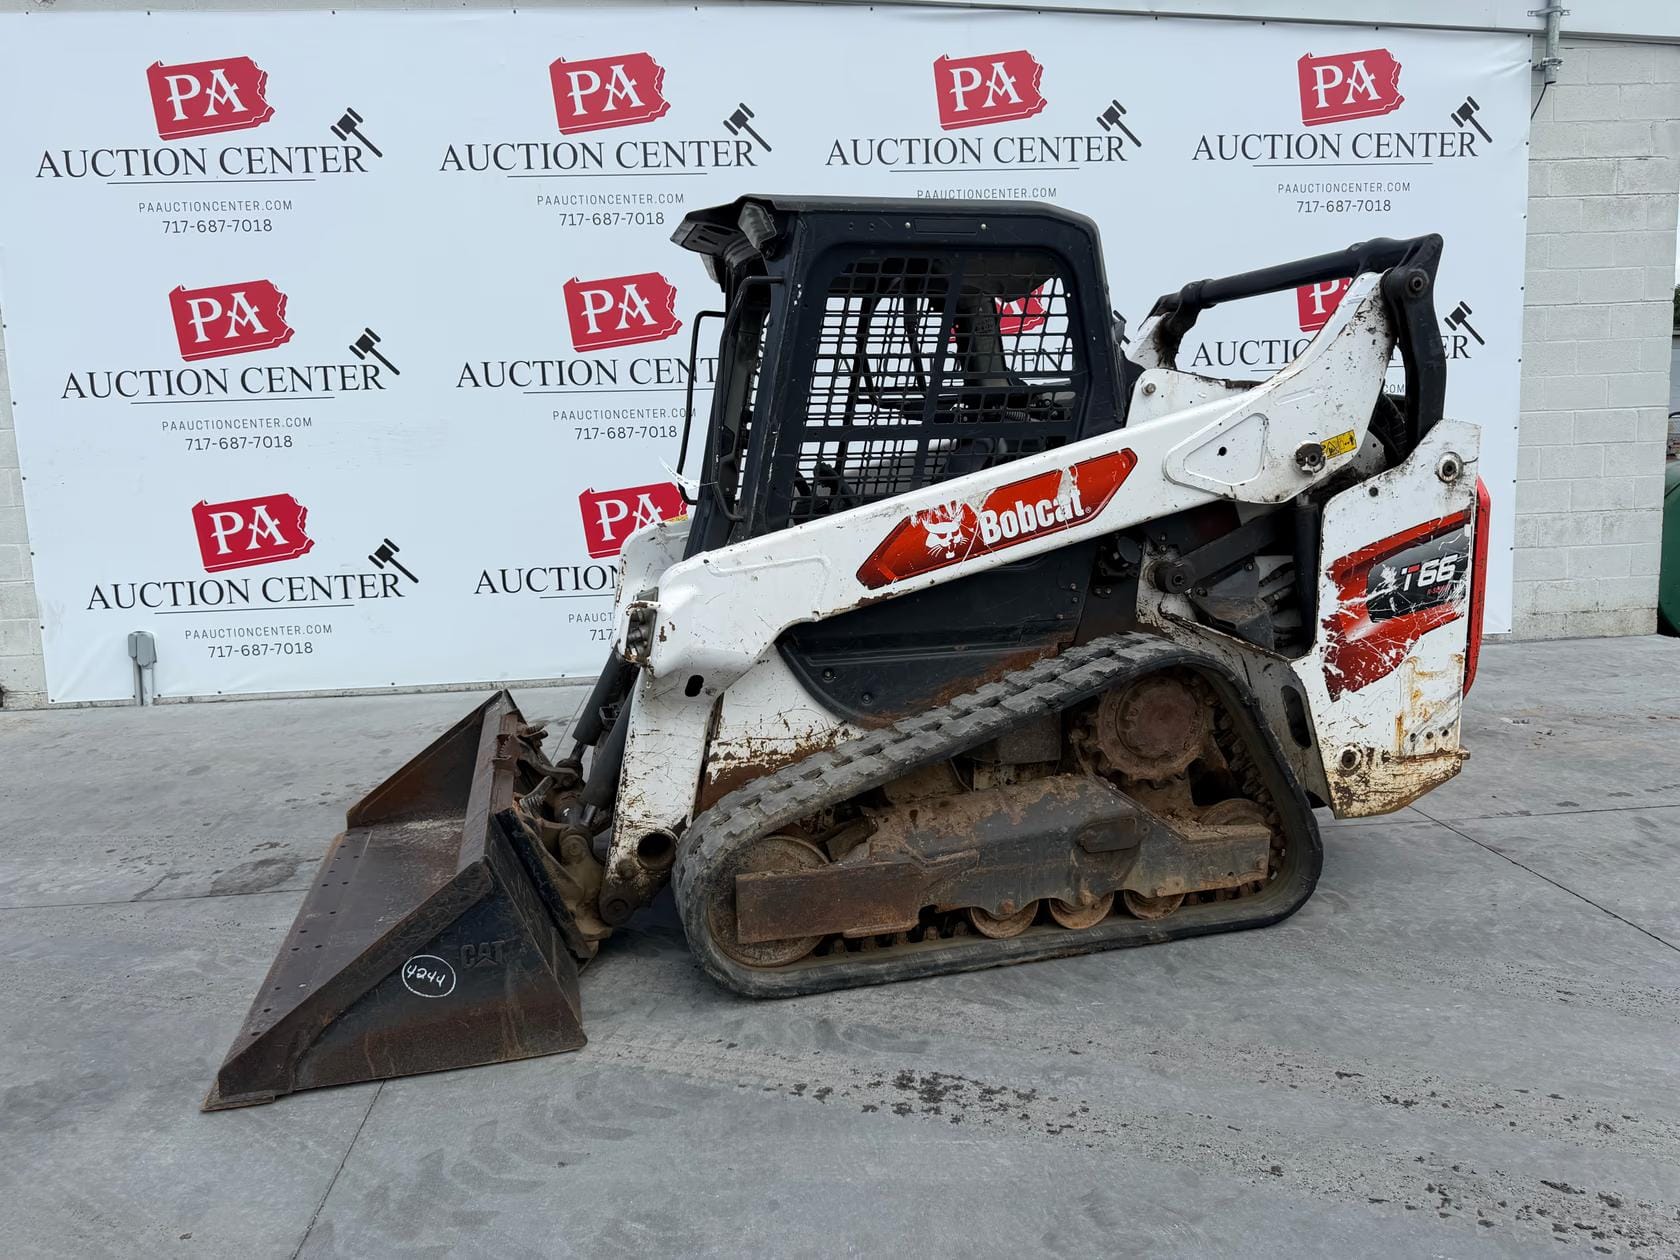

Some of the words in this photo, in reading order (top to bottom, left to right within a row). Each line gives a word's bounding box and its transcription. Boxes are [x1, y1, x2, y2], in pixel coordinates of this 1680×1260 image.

[165, 68, 248, 121] PA
[566, 64, 645, 117] PA
[949, 61, 1024, 112] PA
[1312, 59, 1382, 109] PA
[439, 142, 604, 172] AUCTION
[616, 140, 758, 169] CENTER
[825, 137, 983, 166] AUCTION
[993, 136, 1127, 163] CENTER
[1192, 133, 1342, 161] AUCTION
[1352, 132, 1478, 159] CENTER
[35, 148, 206, 178] AUCTION
[219, 146, 368, 175] CENTER
[536, 193, 684, 206] PAAUCTIONCENTER.COM
[917, 188, 1057, 199] PAAUCTIONCENTER.COM
[1277, 181, 1411, 194] PAAUCTIONCENTER.COM
[138, 199, 293, 213] PAAUCTIONCENTER.COM
[559, 212, 665, 226] 717-687-7018
[1296, 199, 1391, 214] 717-687-7018
[162, 218, 273, 234] 717-687-7018
[186, 291, 269, 343] PA
[580, 284, 658, 335] PA
[61, 368, 228, 399] AUCTION
[240, 363, 387, 394] CENTER
[456, 358, 618, 388] AUCTION
[629, 357, 719, 385] CENT
[162, 416, 313, 432] PAAUCTIONCENTER.COM
[575, 424, 678, 440] 717-687-7018
[185, 435, 293, 451] 717-687-7018
[208, 504, 290, 555] PA
[1401, 554, 1459, 591] T66
[86, 579, 250, 610] AUCTION
[261, 572, 405, 603] CENTER
[185, 623, 333, 640] PAAUCTIONCENTER.COM
[207, 642, 314, 658] 717-687-7018
[461, 941, 505, 969] CAT
[407, 964, 446, 988] 4244
